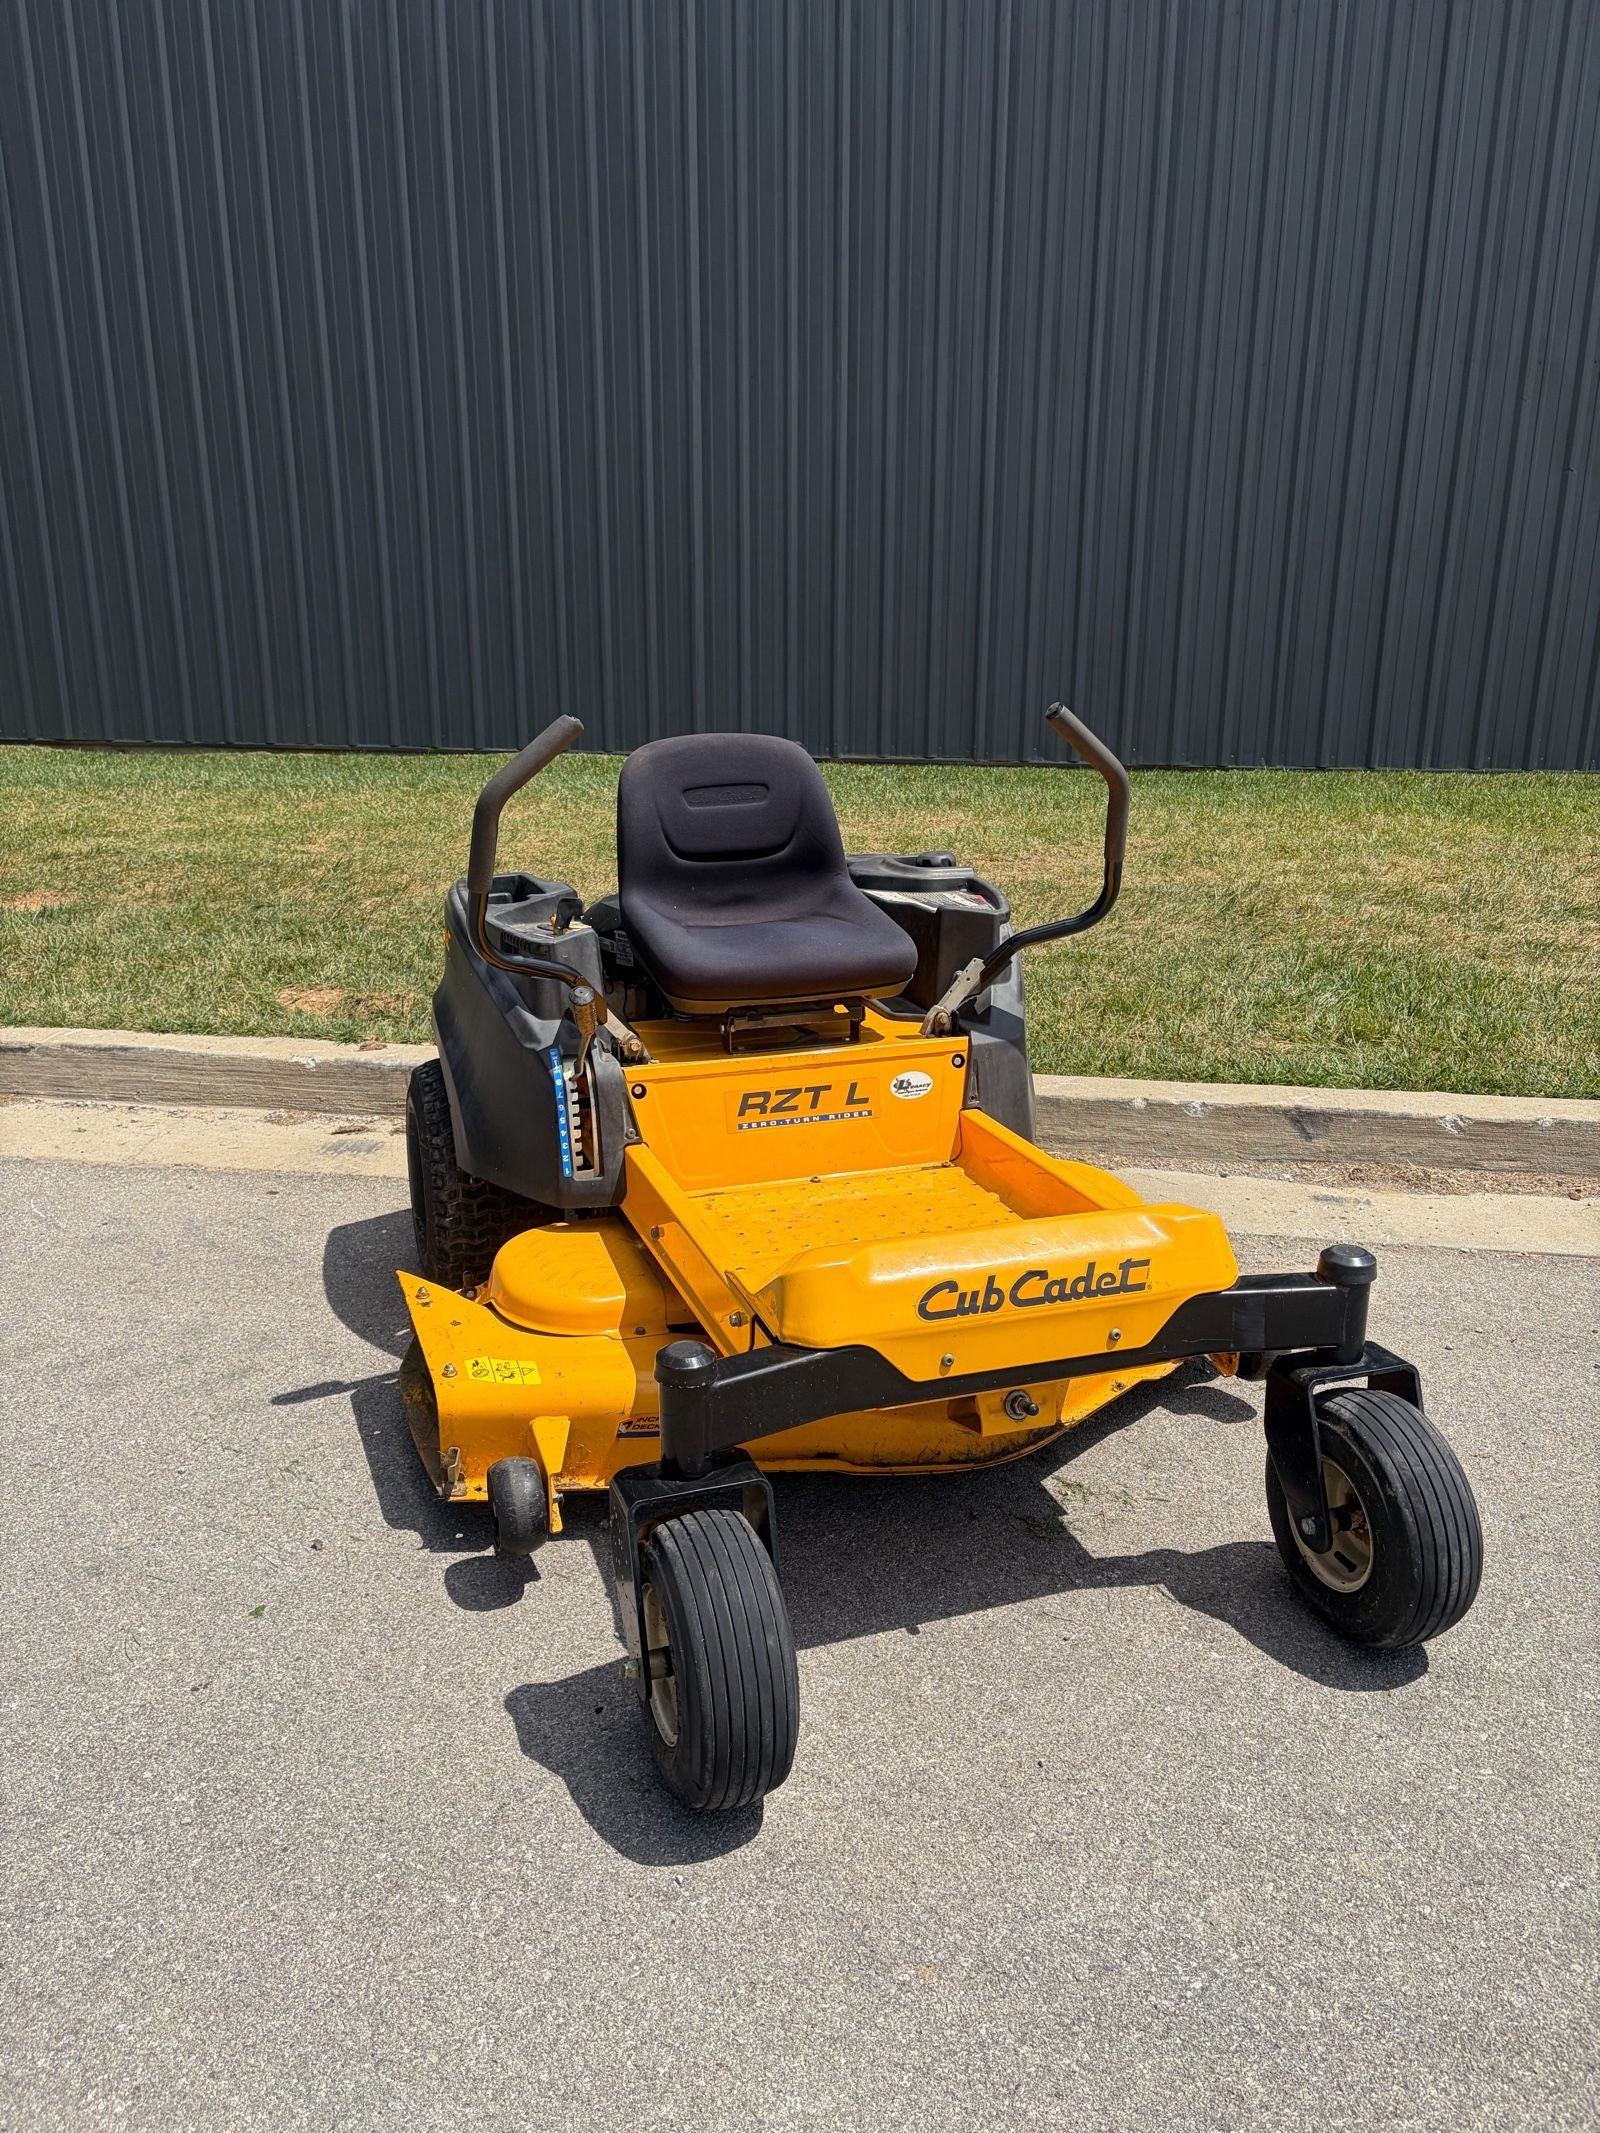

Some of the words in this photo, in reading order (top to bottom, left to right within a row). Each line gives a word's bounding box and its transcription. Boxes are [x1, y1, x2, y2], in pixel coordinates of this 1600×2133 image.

[737, 1084, 832, 1117] RZT
[845, 1082, 870, 1106] L
[828, 1110, 869, 1120] RIDER
[917, 1274, 1005, 1321] Cub
[1009, 1258, 1150, 1308] Cadet
